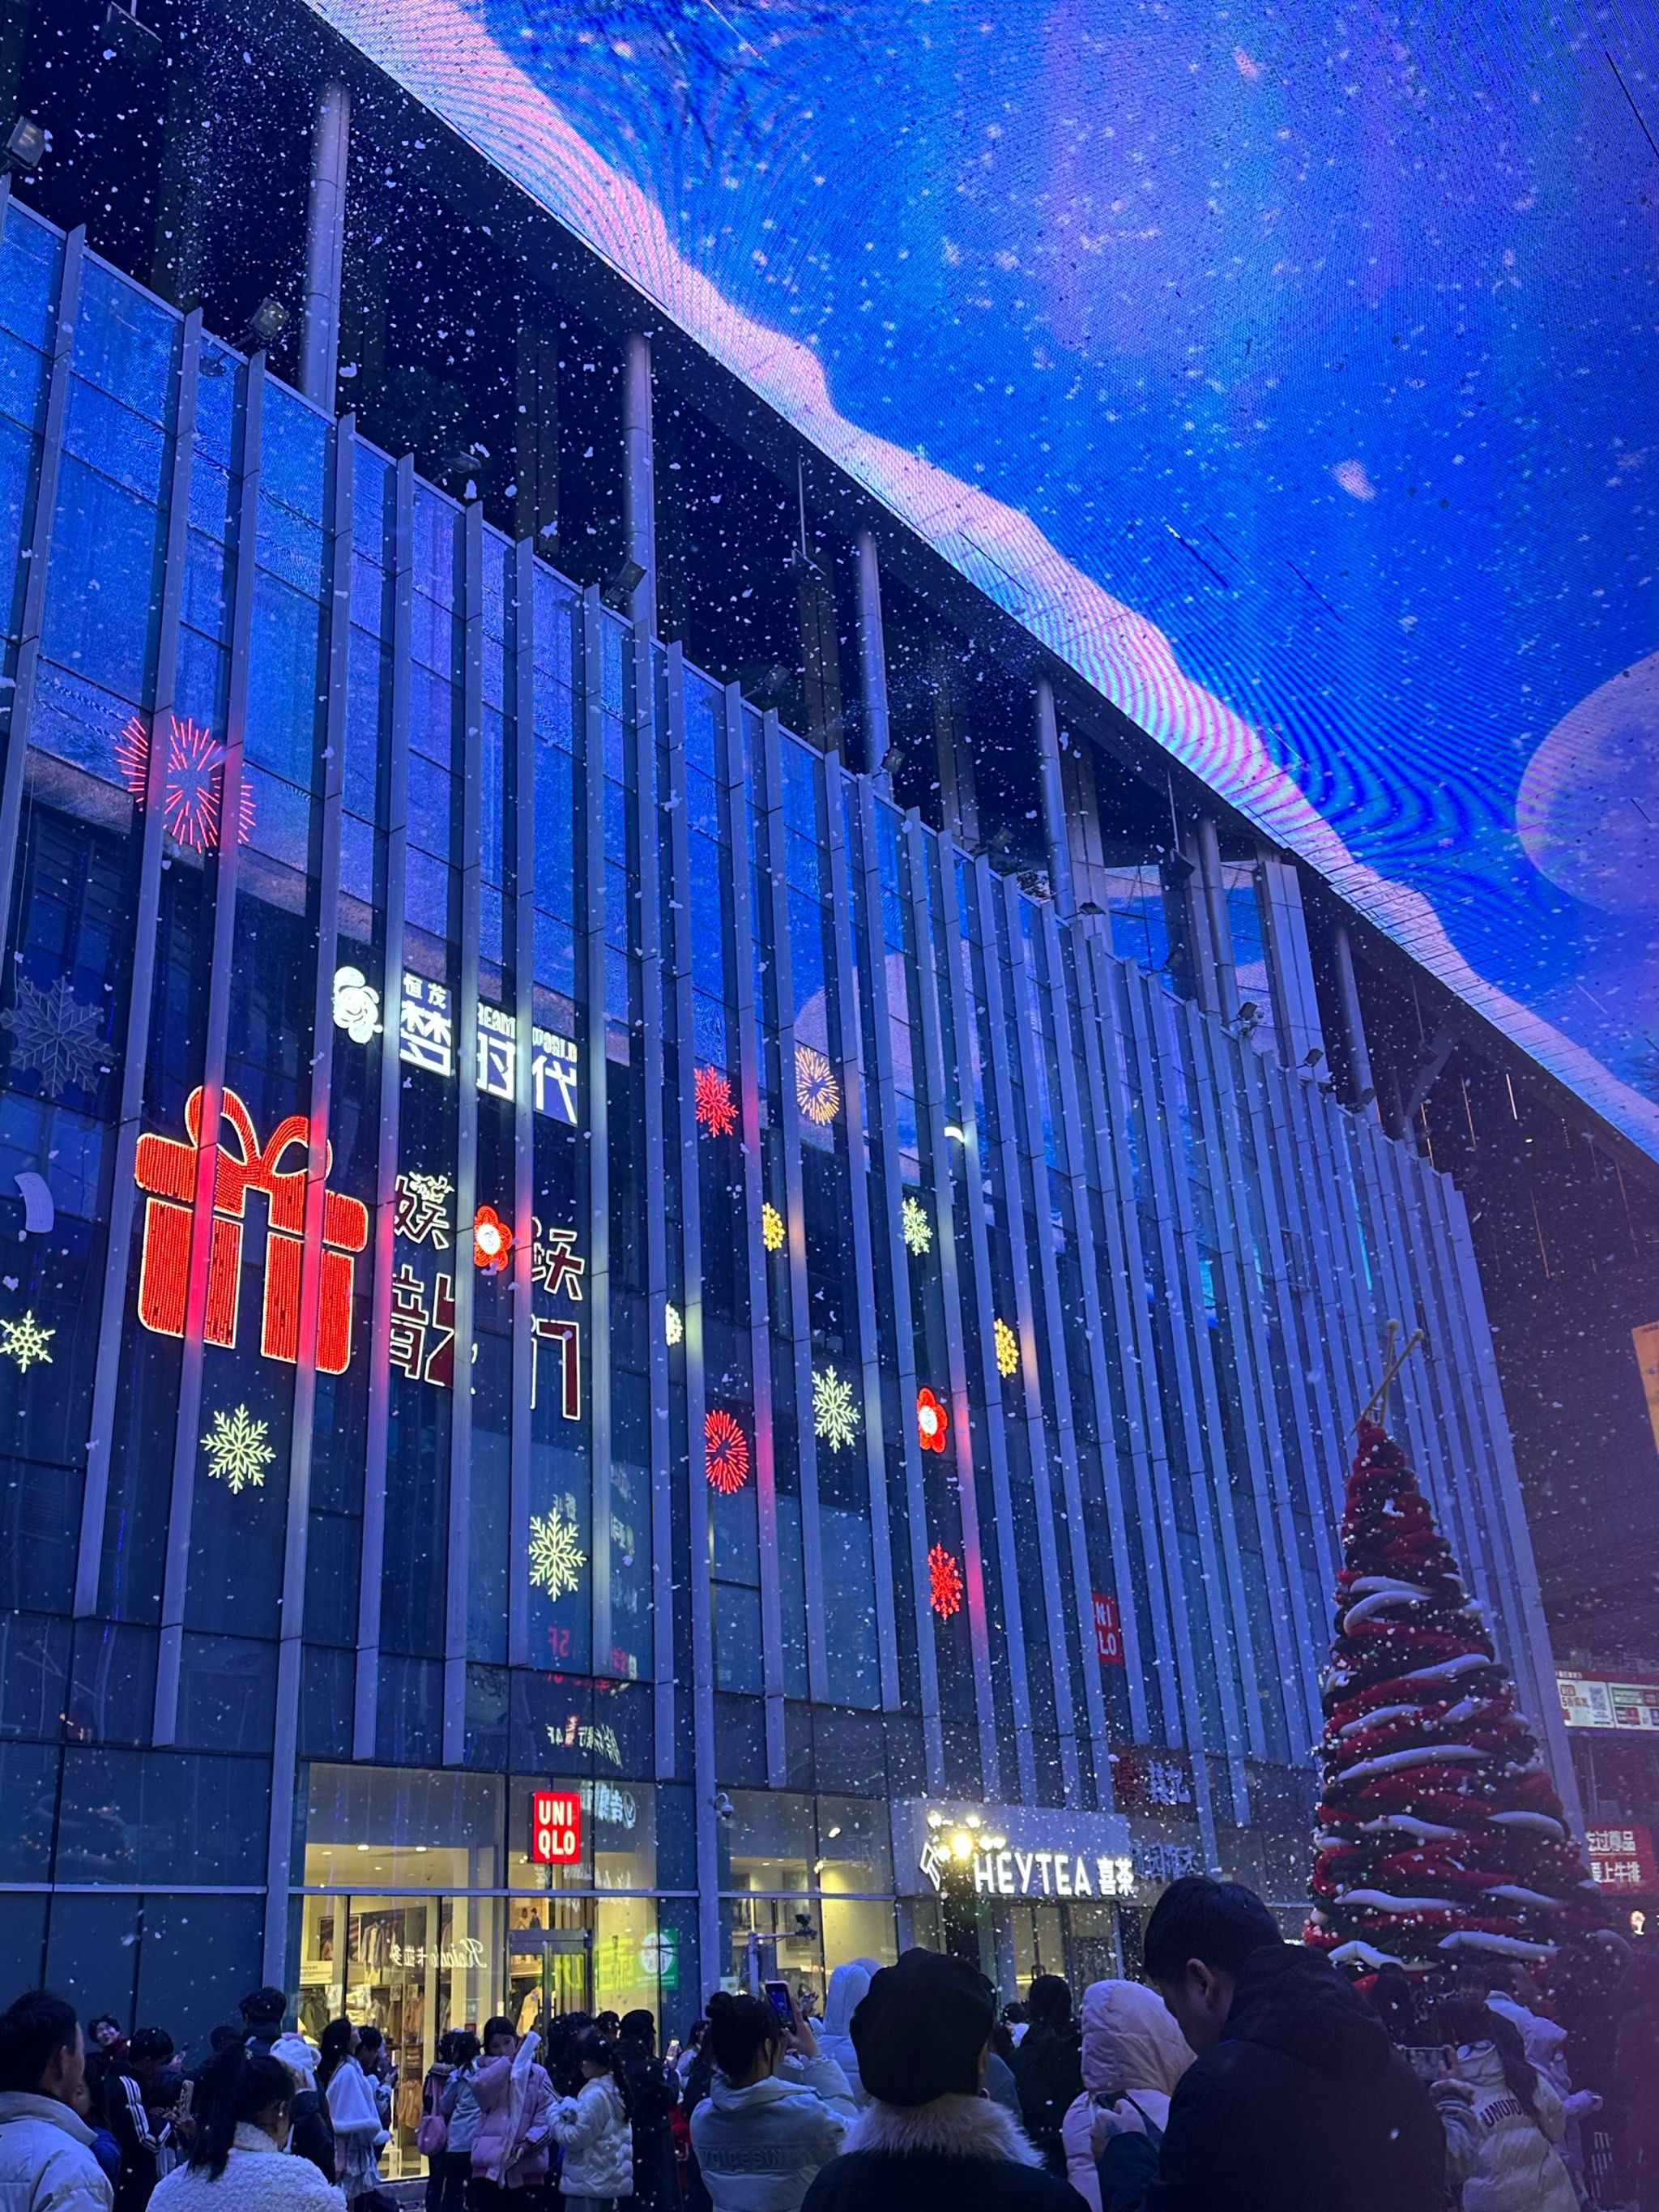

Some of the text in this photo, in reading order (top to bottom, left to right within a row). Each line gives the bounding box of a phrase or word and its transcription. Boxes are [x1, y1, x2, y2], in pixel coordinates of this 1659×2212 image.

[399, 1000, 578, 1125] 梦时代
[1095, 1601, 1112, 1628] NI
[1098, 1630, 1117, 1656] LO
[538, 1800, 573, 1826] UNI
[538, 1829, 576, 1860] QLO
[974, 1851, 1092, 1896] HEYTEA
[1097, 1856, 1134, 1897] 喜茶
